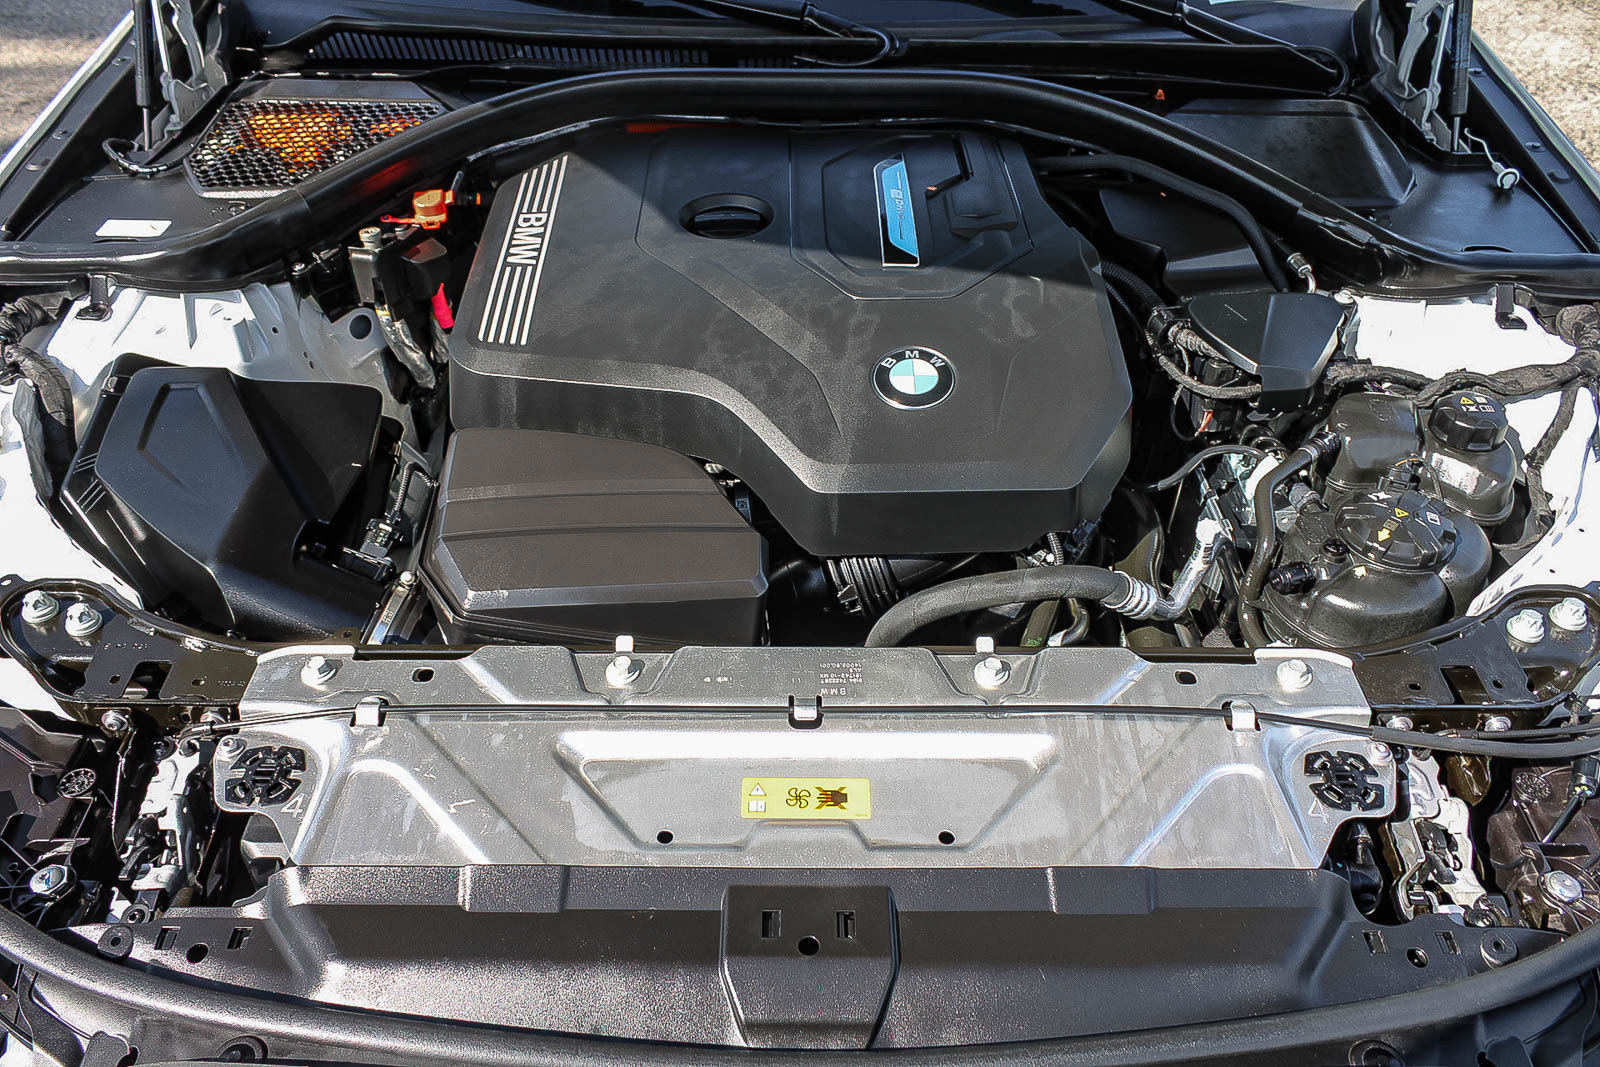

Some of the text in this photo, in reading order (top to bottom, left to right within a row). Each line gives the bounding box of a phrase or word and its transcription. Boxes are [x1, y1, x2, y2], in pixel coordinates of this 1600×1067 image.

[506, 212, 548, 265] BMW
[880, 350, 946, 369] BMW
[820, 687, 846, 696] BMW
[280, 792, 305, 818] 4
